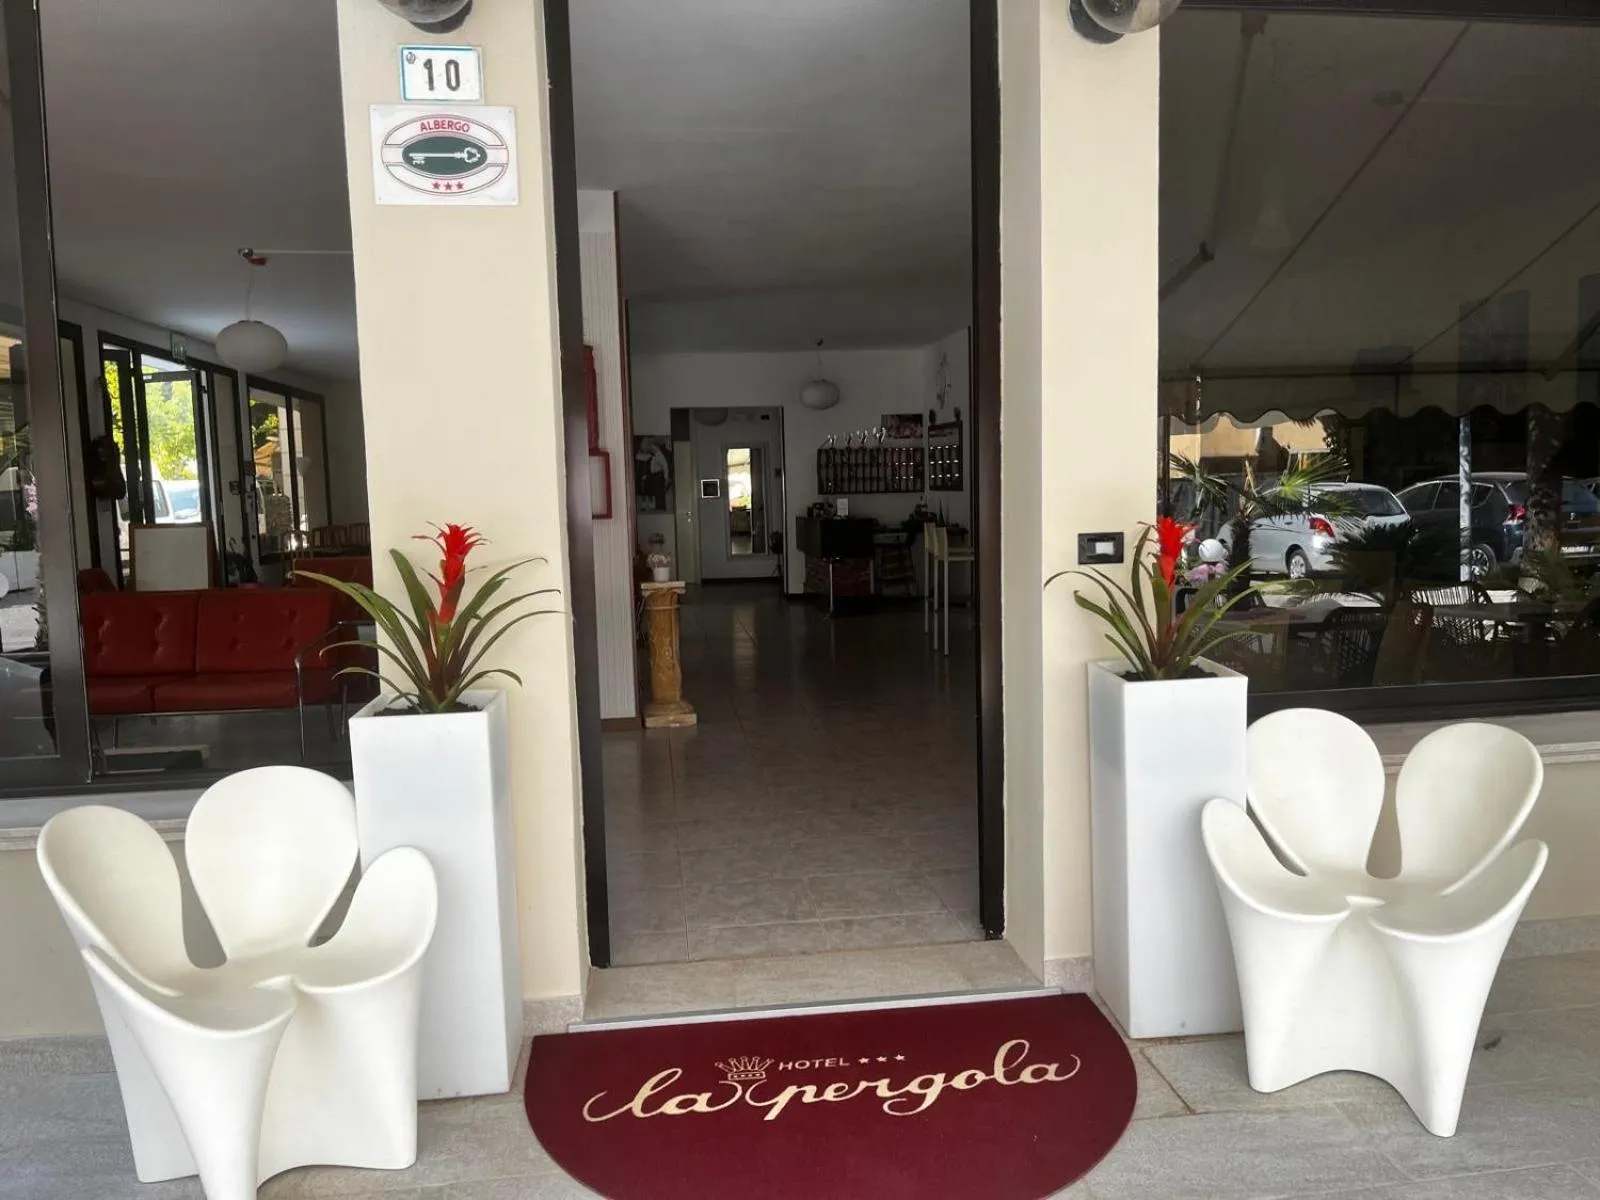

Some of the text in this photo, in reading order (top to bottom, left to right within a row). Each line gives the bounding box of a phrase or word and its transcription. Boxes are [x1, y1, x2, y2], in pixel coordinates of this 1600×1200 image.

[423, 58, 461, 92] 10
[420, 119, 471, 133] ALBERGO
[778, 1056, 850, 1072] HOTEL
[582, 1039, 1081, 1122] la pergola
